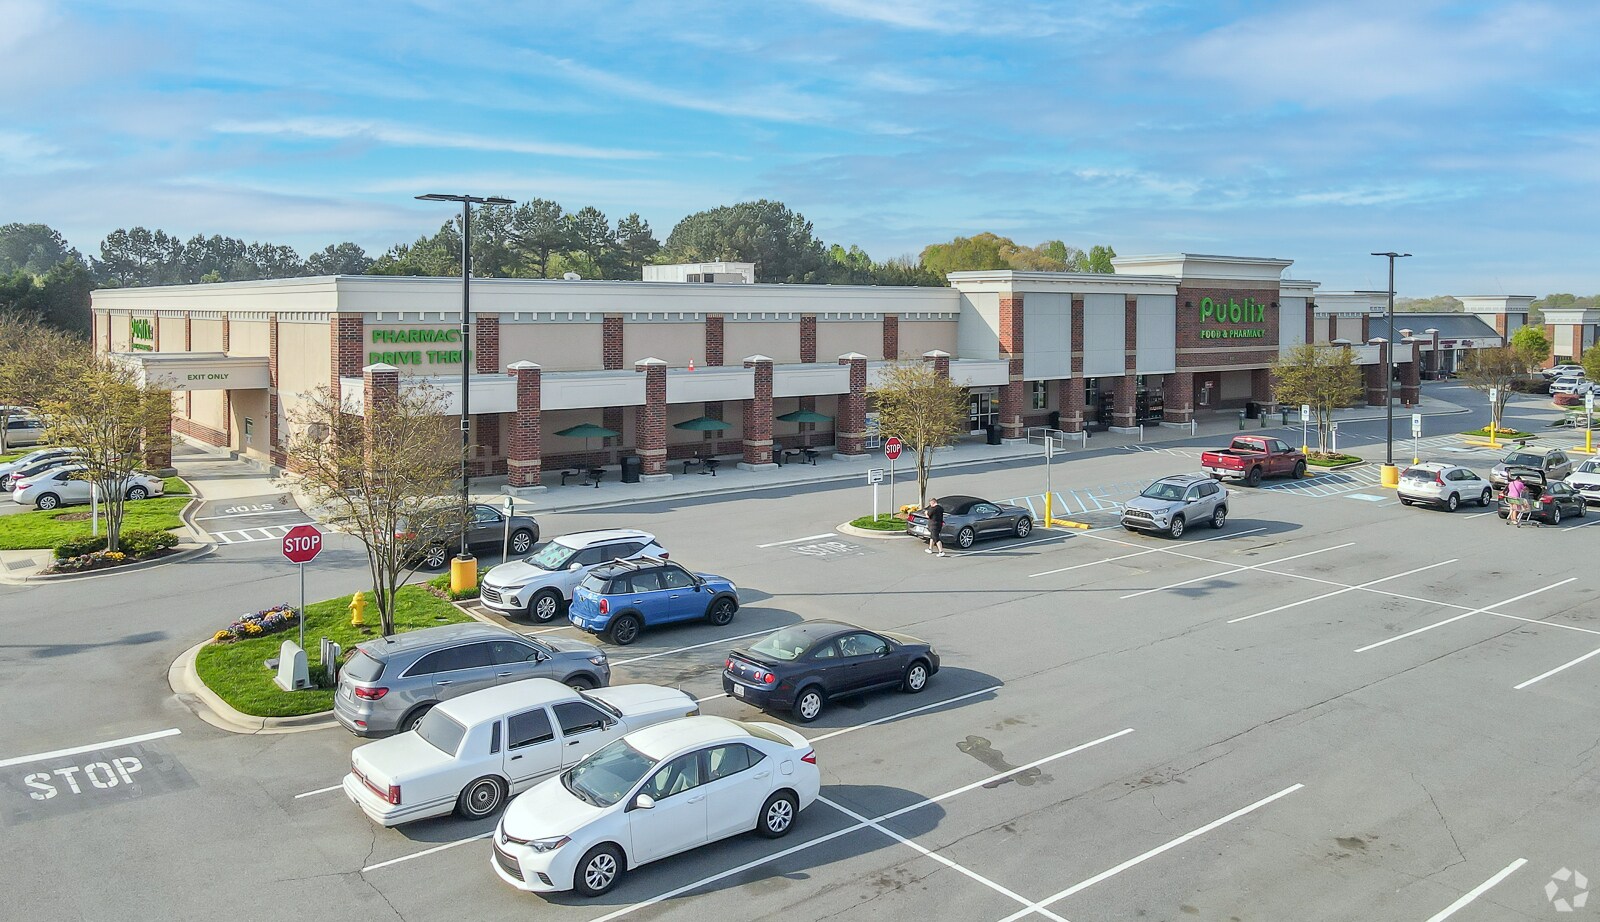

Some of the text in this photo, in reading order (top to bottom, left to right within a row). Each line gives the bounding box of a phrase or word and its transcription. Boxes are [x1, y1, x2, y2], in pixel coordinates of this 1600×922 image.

[1200, 296, 1265, 323] Publix
[372, 329, 463, 343] PHARMACY
[1200, 329, 1265, 339] FOOD & PHARMACY
[369, 351, 422, 365] DRIVE
[886, 443, 901, 454] STOP
[225, 503, 275, 513] STOP
[285, 535, 320, 553] STOP
[23, 756, 143, 800] STOP
